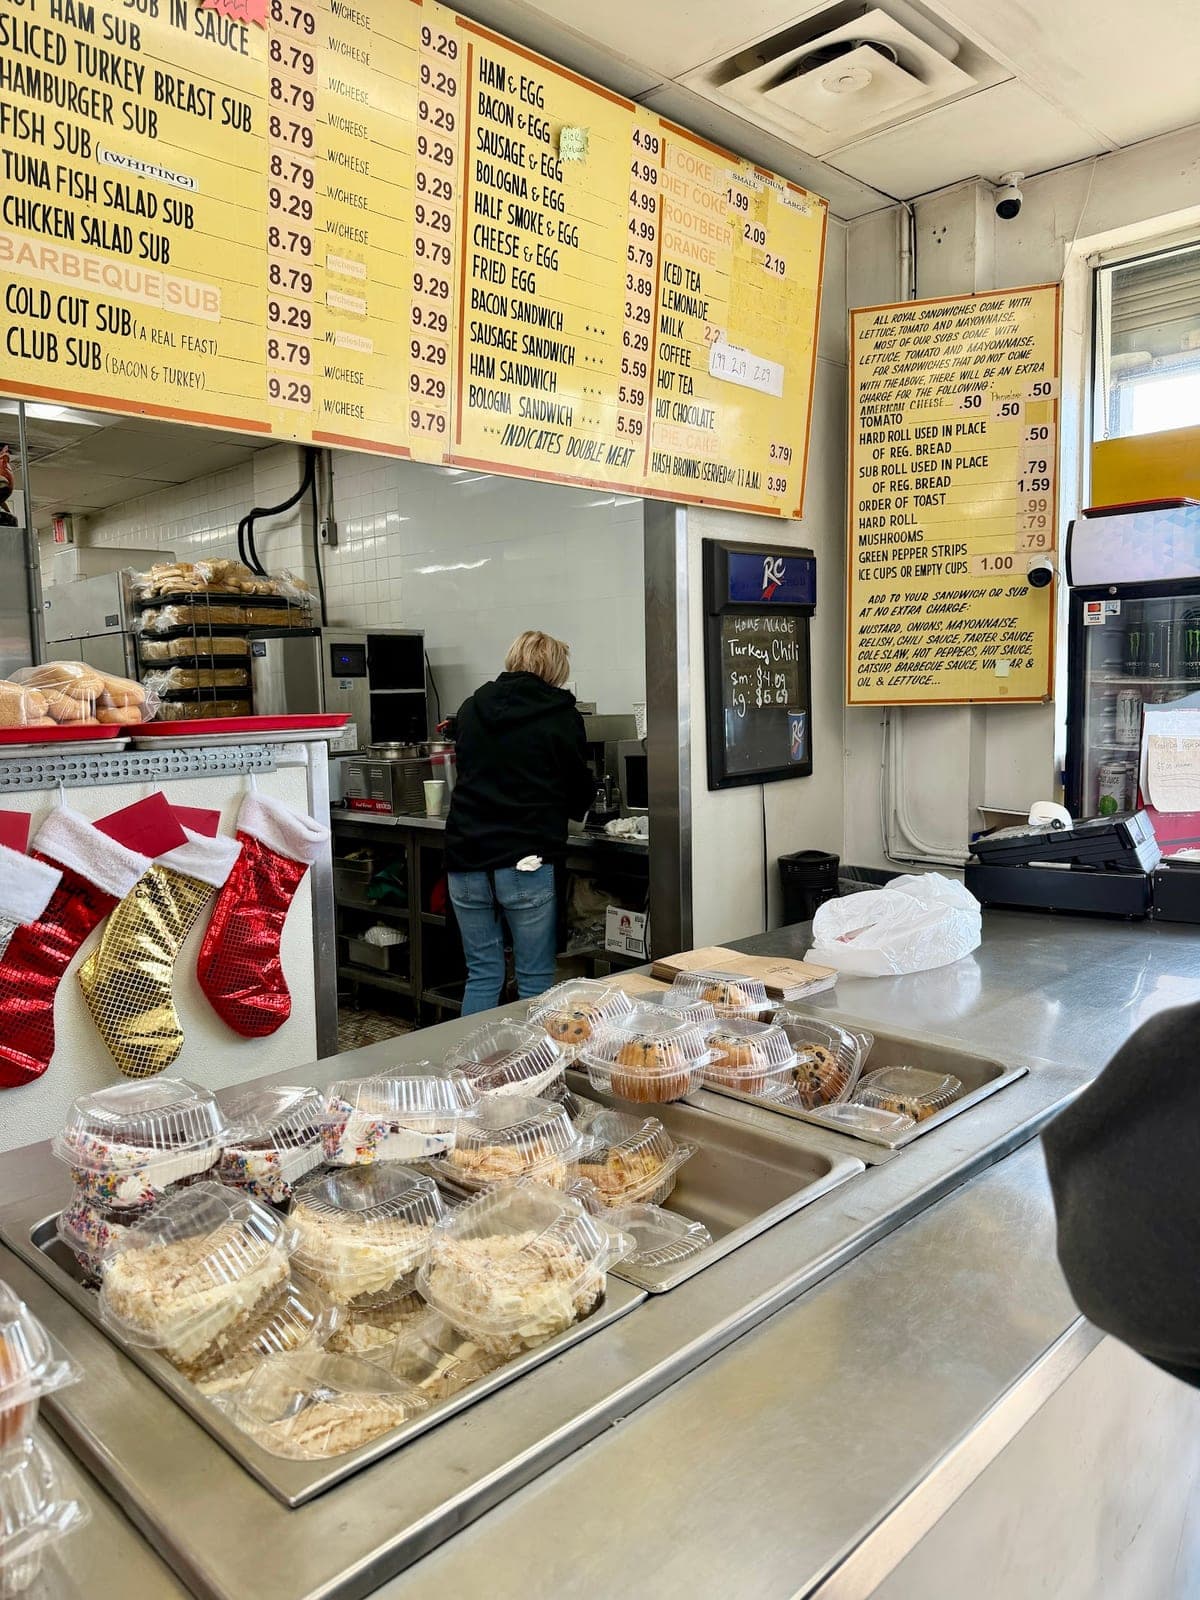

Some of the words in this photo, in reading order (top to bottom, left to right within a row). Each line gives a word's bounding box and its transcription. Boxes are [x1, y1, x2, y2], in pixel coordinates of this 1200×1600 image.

[51, 0, 95, 34] HAM
[102, 13, 141, 51] SUB
[170, 0, 187, 31] IN
[195, 8, 249, 56] SAUCE
[271, 0, 315, 35] 8.79
[330, 0, 371, 31] W/CHEESE
[270, 39, 314, 75] 8.79
[328, 36, 370, 66] W/CHEESE
[421, 26, 458, 60] 9.29
[0, 13, 66, 65] SLICED
[75, 40, 145, 95] TURKEY
[154, 70, 215, 120] BREAST
[221, 97, 252, 133] SUB
[420, 64, 457, 98] 9.29
[479, 56, 505, 91] HAM
[520, 76, 544, 110] EGG
[0, 57, 113, 125] HAMBURGER
[122, 102, 157, 139] SUB
[270, 78, 314, 113] 8.79
[0, 102, 44, 146] FISH
[327, 113, 369, 139] W/CHEESE
[479, 91, 514, 129] BACON
[528, 114, 550, 144] EGG
[269, 116, 313, 149] 8.79
[632, 129, 659, 154] 4.99
[327, 149, 370, 176] W/CHEESE
[476, 127, 526, 169] SAUSAGE
[541, 153, 563, 183] EGG
[676, 152, 712, 178] COKE
[270, 155, 314, 190] 8.79
[476, 160, 528, 200] BOLOGNA
[542, 186, 565, 213] EGG
[631, 161, 657, 185] 4.99
[2, 149, 51, 191] TUNA
[57, 165, 97, 203] FISH
[103, 181, 157, 219] SALAD
[163, 198, 193, 230] SUB
[660, 173, 688, 200] DIET
[692, 186, 727, 215] COKE
[727, 189, 749, 212] 1.99
[269, 188, 313, 220] 9.29
[3, 195, 75, 241] CHICKEN
[80, 216, 133, 254] SALAD
[139, 231, 170, 264] SUB
[326, 220, 369, 245] W/CHEESE
[474, 191, 503, 221] HALF
[507, 204, 544, 236] SMOKE
[557, 221, 578, 249] EGG
[269, 226, 312, 257] 8.79
[473, 224, 520, 259] CHEESE
[664, 232, 716, 266] ORANGE
[744, 224, 766, 246] 2.09
[415, 237, 451, 266] 9.79
[627, 245, 653, 268] 5.79
[765, 254, 785, 276] 2.19
[0, 237, 160, 299] BARBEQUE
[472, 255, 506, 285] FRIED
[663, 261, 681, 286] ICED
[685, 269, 701, 294] TEA
[413, 273, 449, 299] 9.29
[268, 302, 312, 330] 9.29
[471, 288, 508, 318] BACON
[510, 299, 563, 332] SANDWICH
[624, 302, 651, 324] 3.29
[661, 288, 708, 321] LEMONADE
[874, 315, 891, 325] ALL
[891, 310, 917, 324] ROYAL
[919, 302, 976, 320] SANDWICHES
[980, 300, 1004, 313] COME
[1008, 297, 1032, 309] WITH
[6, 284, 51, 319] COLD
[57, 295, 89, 327] CUT
[151, 328, 176, 348] REAL
[181, 335, 218, 356] FEAST)
[660, 315, 684, 339] MILK
[933, 320, 952, 331] AND
[268, 339, 310, 365] 8.79
[470, 321, 518, 352] SAUSAGE
[521, 334, 575, 366] SANDWICH
[622, 331, 649, 352] 6.29
[659, 343, 691, 367] COFFEE
[874, 338, 898, 350] MOST
[900, 337, 911, 348] OF
[914, 335, 932, 346] OUR
[935, 332, 959, 344] SUBS
[7, 327, 58, 362] CLUB
[66, 338, 101, 370] SUB
[163, 367, 205, 390] TURKEY)
[872, 364, 890, 376] FOR
[324, 366, 364, 386] W/CHEESE
[470, 353, 495, 380] HAM
[499, 361, 557, 393] SANDWICH
[657, 368, 674, 390] HOT
[678, 375, 694, 396] TEA
[268, 378, 311, 403] 9.29
[469, 384, 512, 415] BOLOGNA
[618, 386, 644, 406] 5.59
[860, 391, 893, 405] CHARGE
[916, 386, 933, 398] THE
[959, 394, 982, 410] .50
[1027, 382, 1052, 397] .50
[410, 410, 446, 434] 9.79
[655, 397, 669, 419] HOT
[672, 401, 716, 429] CHOCOLATE
[860, 413, 903, 428] TOMATO
[500, 423, 562, 454] INDICATES
[566, 436, 605, 463] DOUBLE
[605, 444, 635, 468] MEAT
[859, 431, 886, 446] HARD
[887, 427, 911, 442] ROLL
[914, 425, 938, 440] USED
[942, 425, 952, 437] IN
[955, 422, 987, 436] PLACE
[872, 448, 885, 460] OF
[890, 445, 912, 457] REG.
[916, 442, 952, 456] BREAD
[652, 451, 671, 475] HASH
[673, 456, 701, 480] BROWNS
[859, 466, 878, 479] SUB
[881, 462, 907, 476] ROLL
[911, 459, 937, 474] USED
[941, 459, 952, 471] IN
[956, 455, 989, 470] PLACE
[767, 476, 787, 493] 3.99
[1017, 478, 1050, 493] 1.59
[859, 498, 891, 513] ORDER
[895, 496, 909, 509] OF
[914, 493, 946, 508] TOAST
[1023, 499, 1047, 513] .99
[858, 530, 924, 547] MUSHROOMS
[858, 549, 888, 563] GREEN
[892, 545, 928, 560] PEPPER
[931, 543, 967, 558] STRIPS
[981, 556, 1013, 570] 1.00
[762, 556, 786, 590] RC
[858, 569, 871, 581] ICE
[914, 563, 941, 577] EMPTY
[868, 595, 886, 605] ADD
[728, 639, 769, 665] Turkey
[771, 638, 800, 661] Chili
